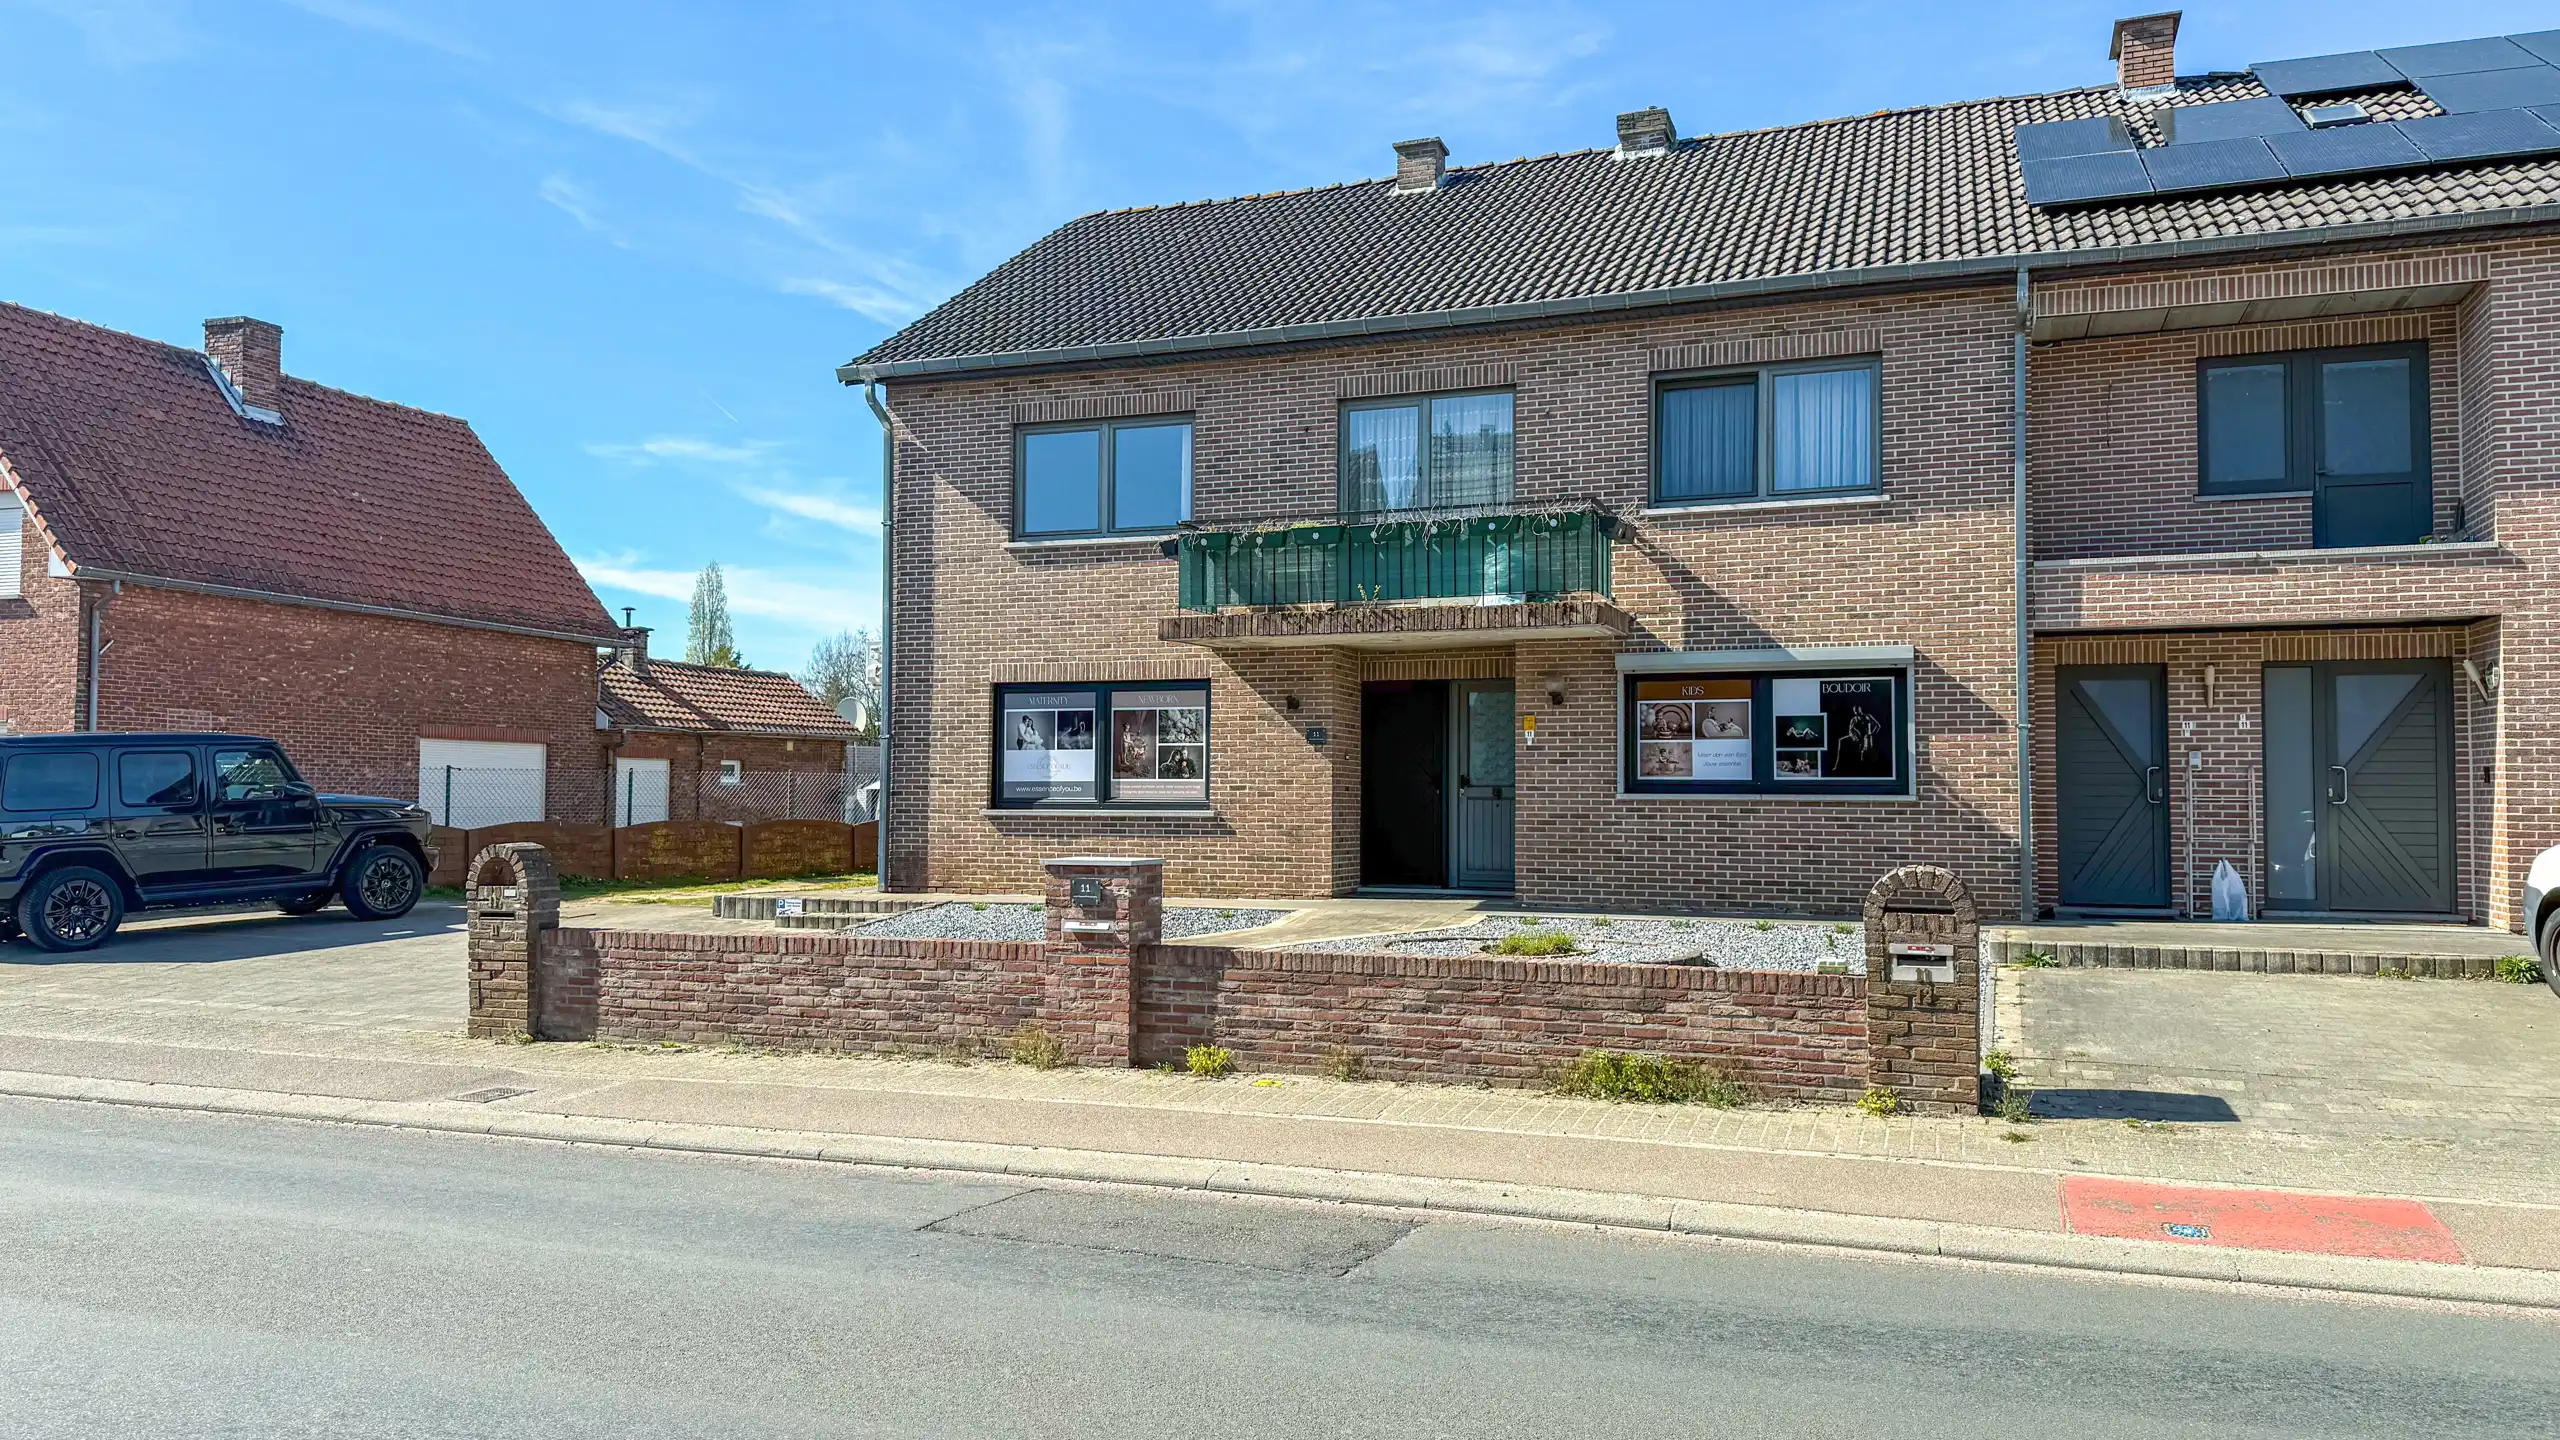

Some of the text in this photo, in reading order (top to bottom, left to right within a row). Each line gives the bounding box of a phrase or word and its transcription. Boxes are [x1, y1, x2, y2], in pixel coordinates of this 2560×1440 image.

[1681, 686, 1704, 696] KIDS
[1822, 683, 1872, 693] BOUDOIR
[1028, 696, 1069, 705] MATERNITY
[1138, 694, 1180, 704] NEWBORN
[1015, 785, 1082, 794] www.essenceofyou.be
[1080, 884, 1091, 893] 11
